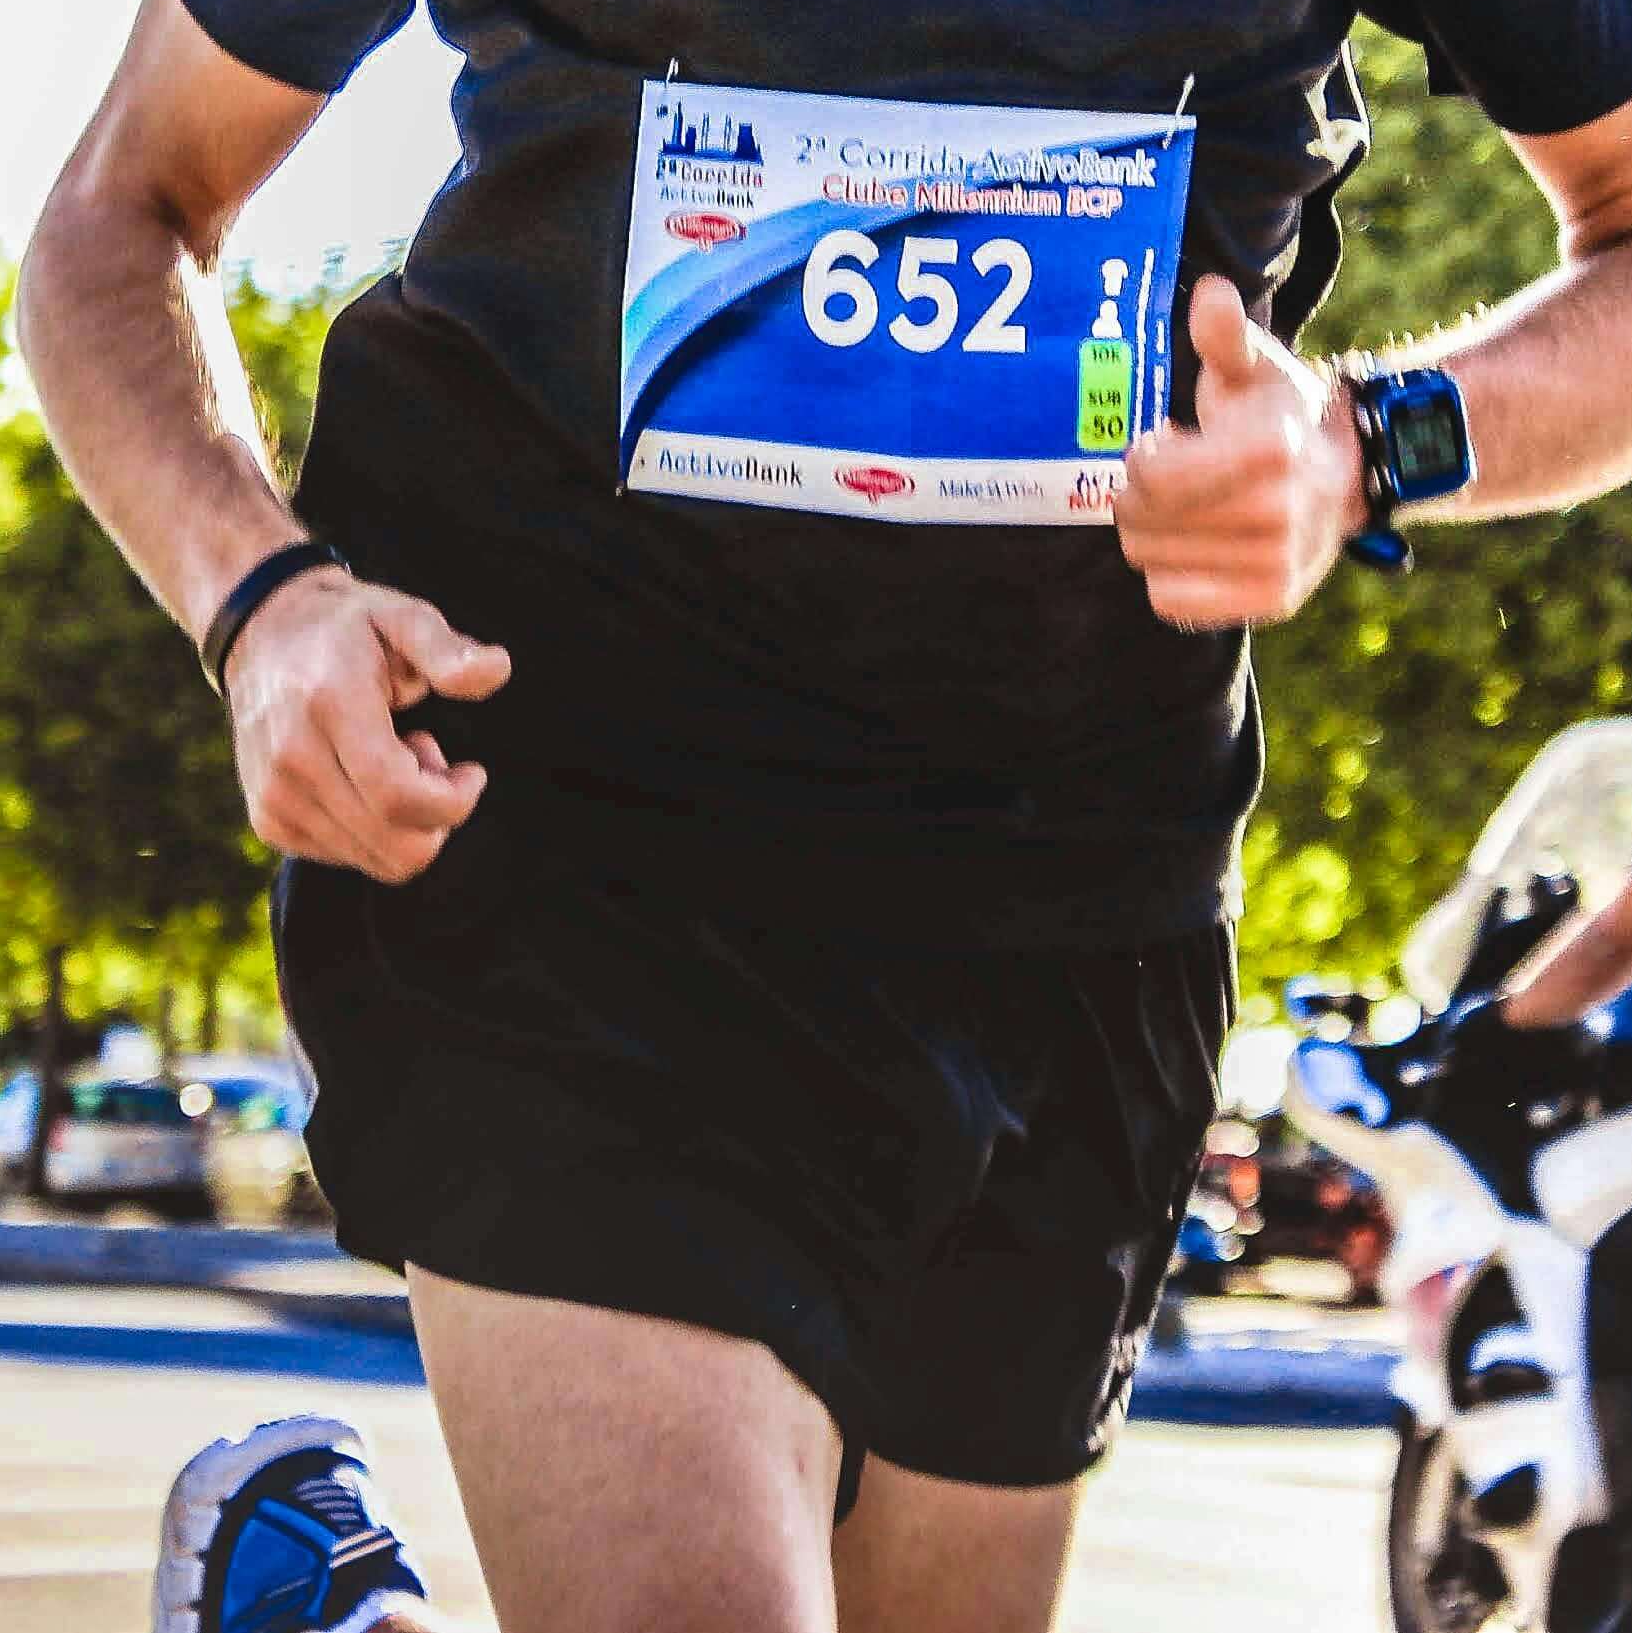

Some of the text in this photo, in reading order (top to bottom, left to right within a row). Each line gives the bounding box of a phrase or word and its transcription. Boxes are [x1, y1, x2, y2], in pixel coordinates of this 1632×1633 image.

[839, 136, 966, 176] Corrida
[821, 172, 1124, 219] Clube Millennium BCP
[801, 228, 1033, 353] 652
[1093, 414, 1125, 440] 50
[658, 447, 804, 490] ActivoBank
